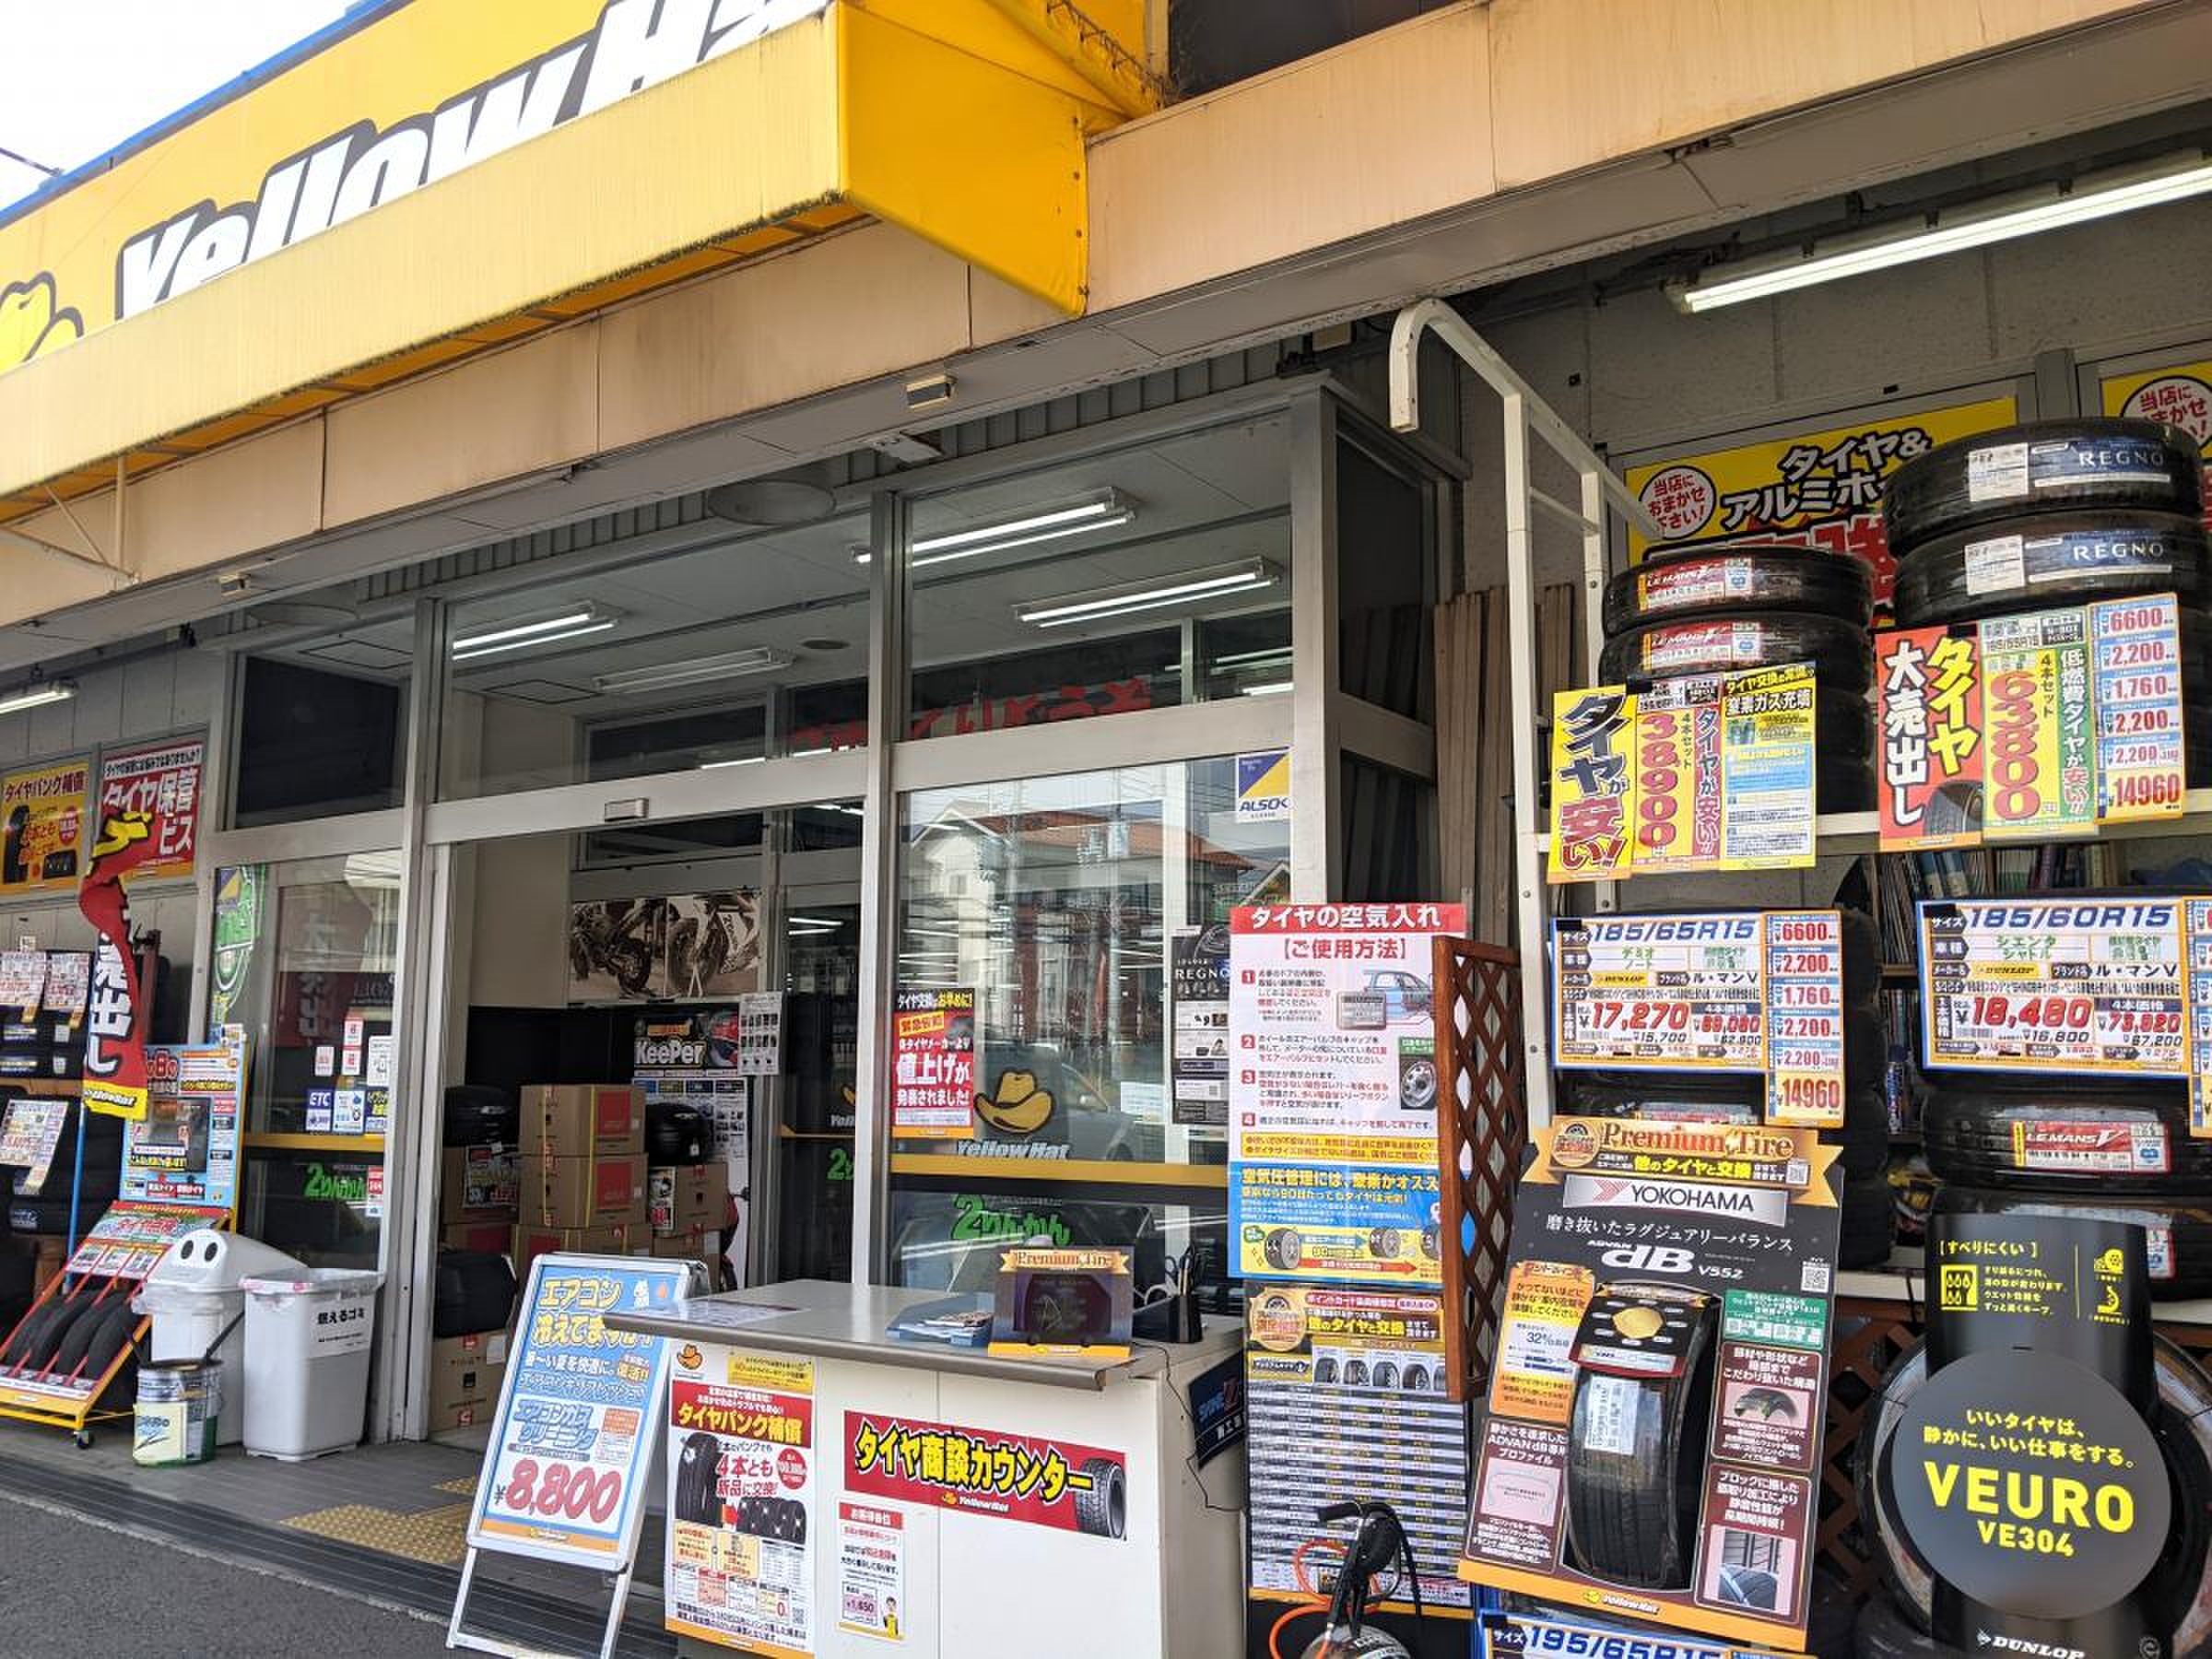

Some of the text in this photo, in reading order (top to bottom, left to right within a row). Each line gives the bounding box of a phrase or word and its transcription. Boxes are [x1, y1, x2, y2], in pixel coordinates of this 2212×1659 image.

[2140, 385, 2192, 412] 当店に
[1782, 429, 1932, 482] タイヤ&
[2079, 451, 2163, 466] REGNO
[1653, 475, 1695, 495] 当店に
[1648, 488, 1705, 517] おまかせ
[1723, 473, 1887, 529] アルミホ
[2074, 543, 2163, 560] REGNO
[2039, 653, 2055, 719] 4本セット
[1927, 637, 1981, 775] タイヤ
[1884, 641, 1929, 826] 大売出し
[1239, 797, 1290, 812] ALSOK
[1250, 905, 1441, 929] タイヤの空気入れ
[1971, 907, 2174, 929] 185/60R15
[635, 1039, 707, 1065] KeePer
[896, 1053, 971, 1085] 値上げが
[309, 1091, 330, 1106] ETC
[1602, 1122, 1724, 1153] Premium
[1630, 1183, 1755, 1212] YOKOHAMA
[1544, 1212, 1795, 1253] 磨き抜いたラグジュアリーバランス
[1601, 1243, 1696, 1274] dB
[538, 1277, 622, 1311] エアコン
[677, 1402, 803, 1445] タイヤパンク補償
[1965, 1408, 2087, 1439] いいタイヤは、
[855, 1416, 1094, 1502] タイヤ商談カウンター
[1923, 1425, 2137, 1470] 静かに、いい仕事をする。
[714, 1453, 773, 1478] 4本とも
[716, 1478, 779, 1498] 新品に交換!
[1923, 1460, 2136, 1535] VEURO
[1976, 1518, 2076, 1558] VE304
[1493, 1628, 1524, 1645] サイズ
